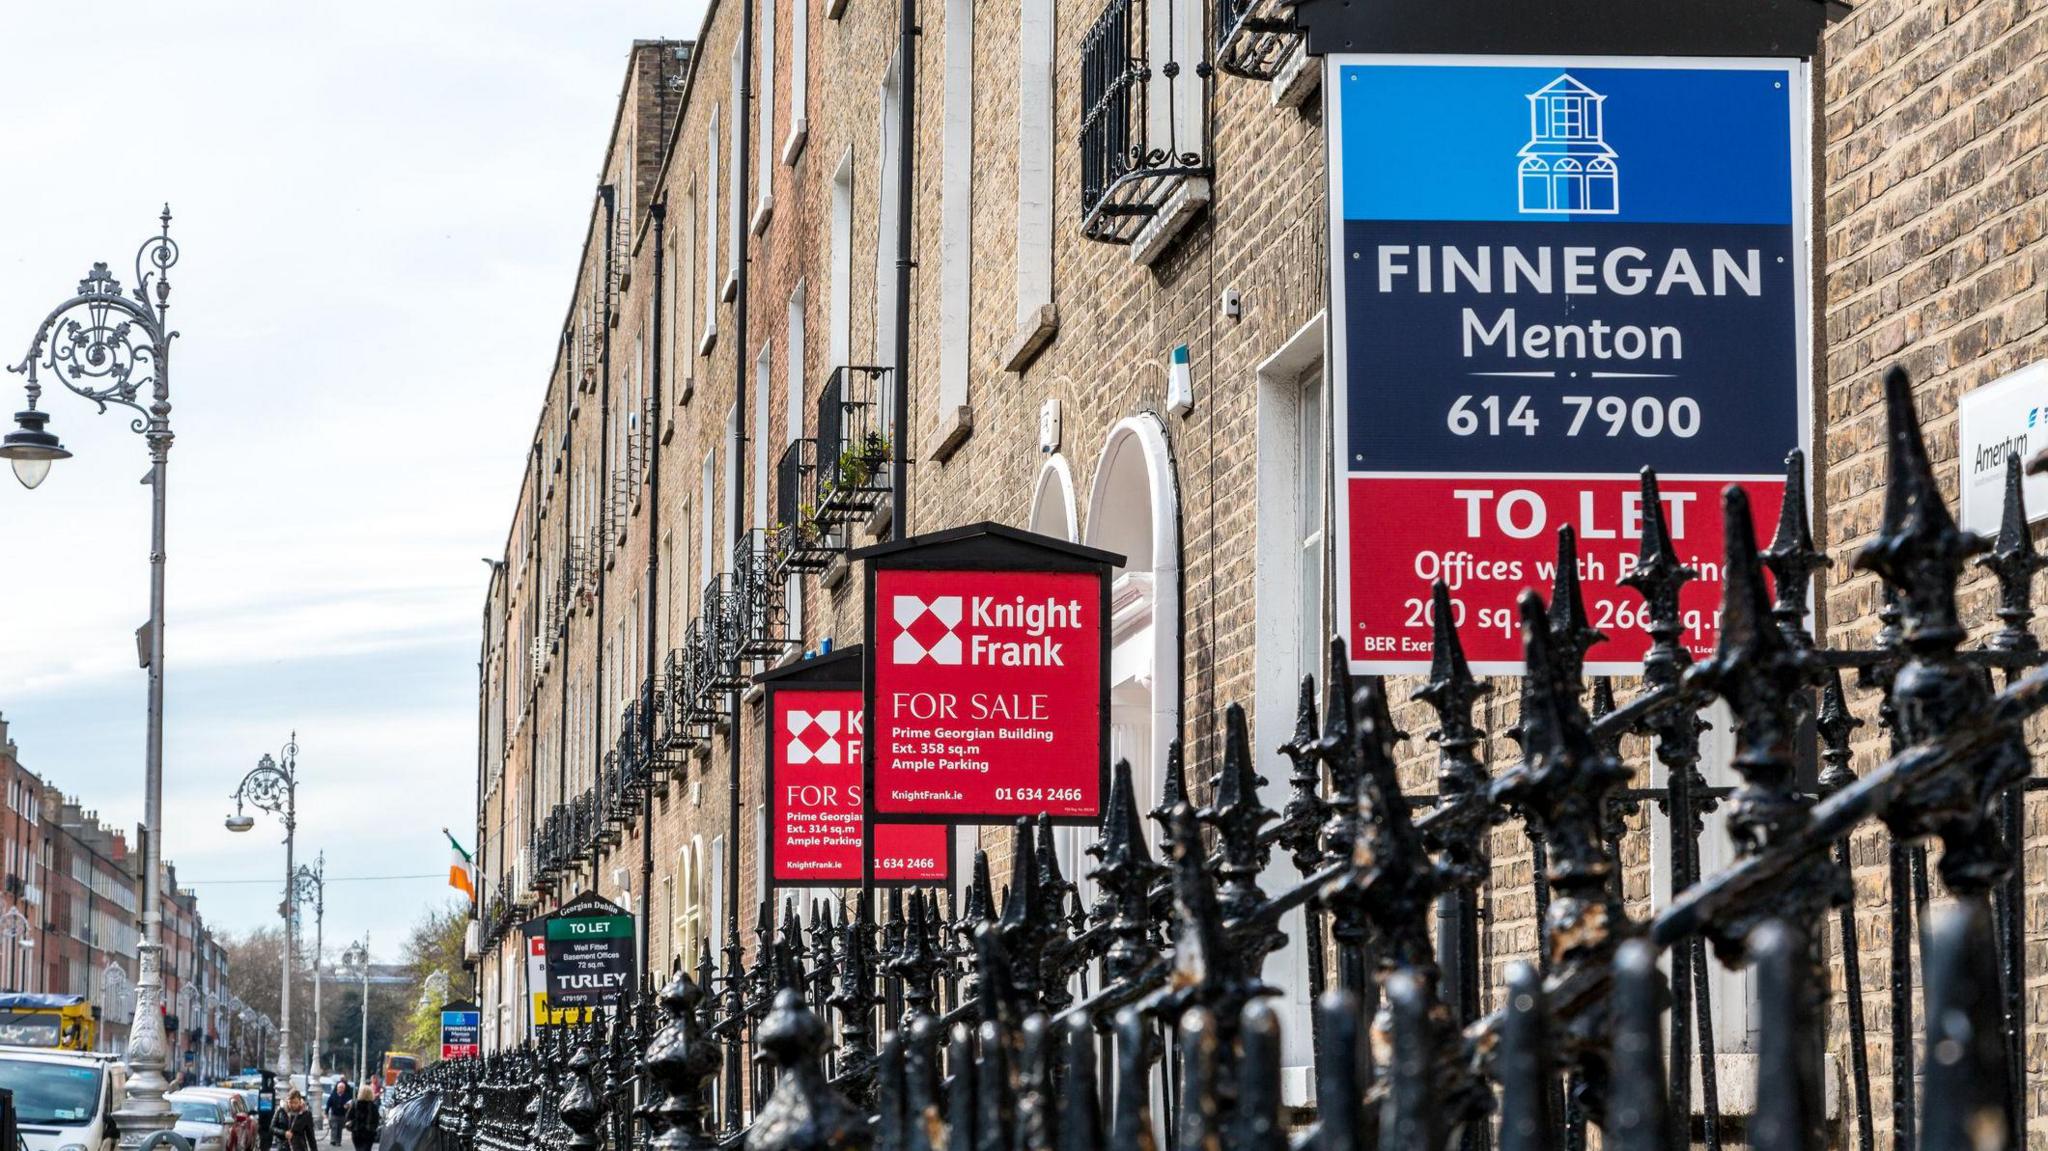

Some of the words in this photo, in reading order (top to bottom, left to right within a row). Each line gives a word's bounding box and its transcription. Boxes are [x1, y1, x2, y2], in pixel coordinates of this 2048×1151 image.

[1377, 244, 1762, 297] FINNEGAN
[1461, 307, 1683, 360] Menton
[1446, 395, 1540, 437] 614
[1561, 395, 1701, 438] 7900
[1974, 433, 2028, 475] Amentum
[1453, 489, 1548, 540] TO
[1579, 490, 1697, 540] LET
[1413, 549, 1524, 591] Offices
[1535, 552, 1606, 581] wth
[971, 595, 1083, 637] Knight
[1477, 607, 1522, 640] sq.
[1594, 599, 1652, 630] 266
[971, 634, 1065, 667] Frank
[1364, 636, 1397, 652] BER
[1401, 636, 1434, 652] Exe
[892, 692, 959, 720] FOR
[970, 693, 1050, 721] SALE
[892, 727, 932, 740] Prime
[934, 727, 995, 742] Georgian
[999, 727, 1054, 743] Building
[892, 743, 917, 755] Ext.
[921, 743, 945, 755] 358
[947, 745, 980, 757] sq.m
[891, 758, 936, 773] Ample
[938, 759, 989, 773] Parking
[787, 785, 838, 807] FOR
[891, 789, 963, 802] KnightFrank.ie
[995, 787, 1013, 801] 01
[1016, 787, 1043, 801] 634
[1047, 788, 1083, 802] 2466
[786, 812, 817, 822] Prime
[786, 824, 806, 834] Ext.
[809, 824, 828, 834] 314
[829, 825, 856, 836] sq.m
[786, 836, 820, 848] Ample
[823, 836, 862, 848] Parking
[786, 861, 843, 871] KnightFrank.ie
[883, 858, 904, 869] 634
[906, 858, 934, 869] 2466
[560, 901, 593, 917] Georgian
[594, 901, 618, 914] Dublin
[569, 923, 586, 934] TO
[588, 922, 611, 934] LET
[573, 943, 589, 952] Well
[589, 943, 609, 951] Fitted
[562, 952, 596, 961] Basement
[596, 951, 620, 960] Offices
[577, 961, 587, 969] 72
[556, 972, 627, 989] TURLEY
